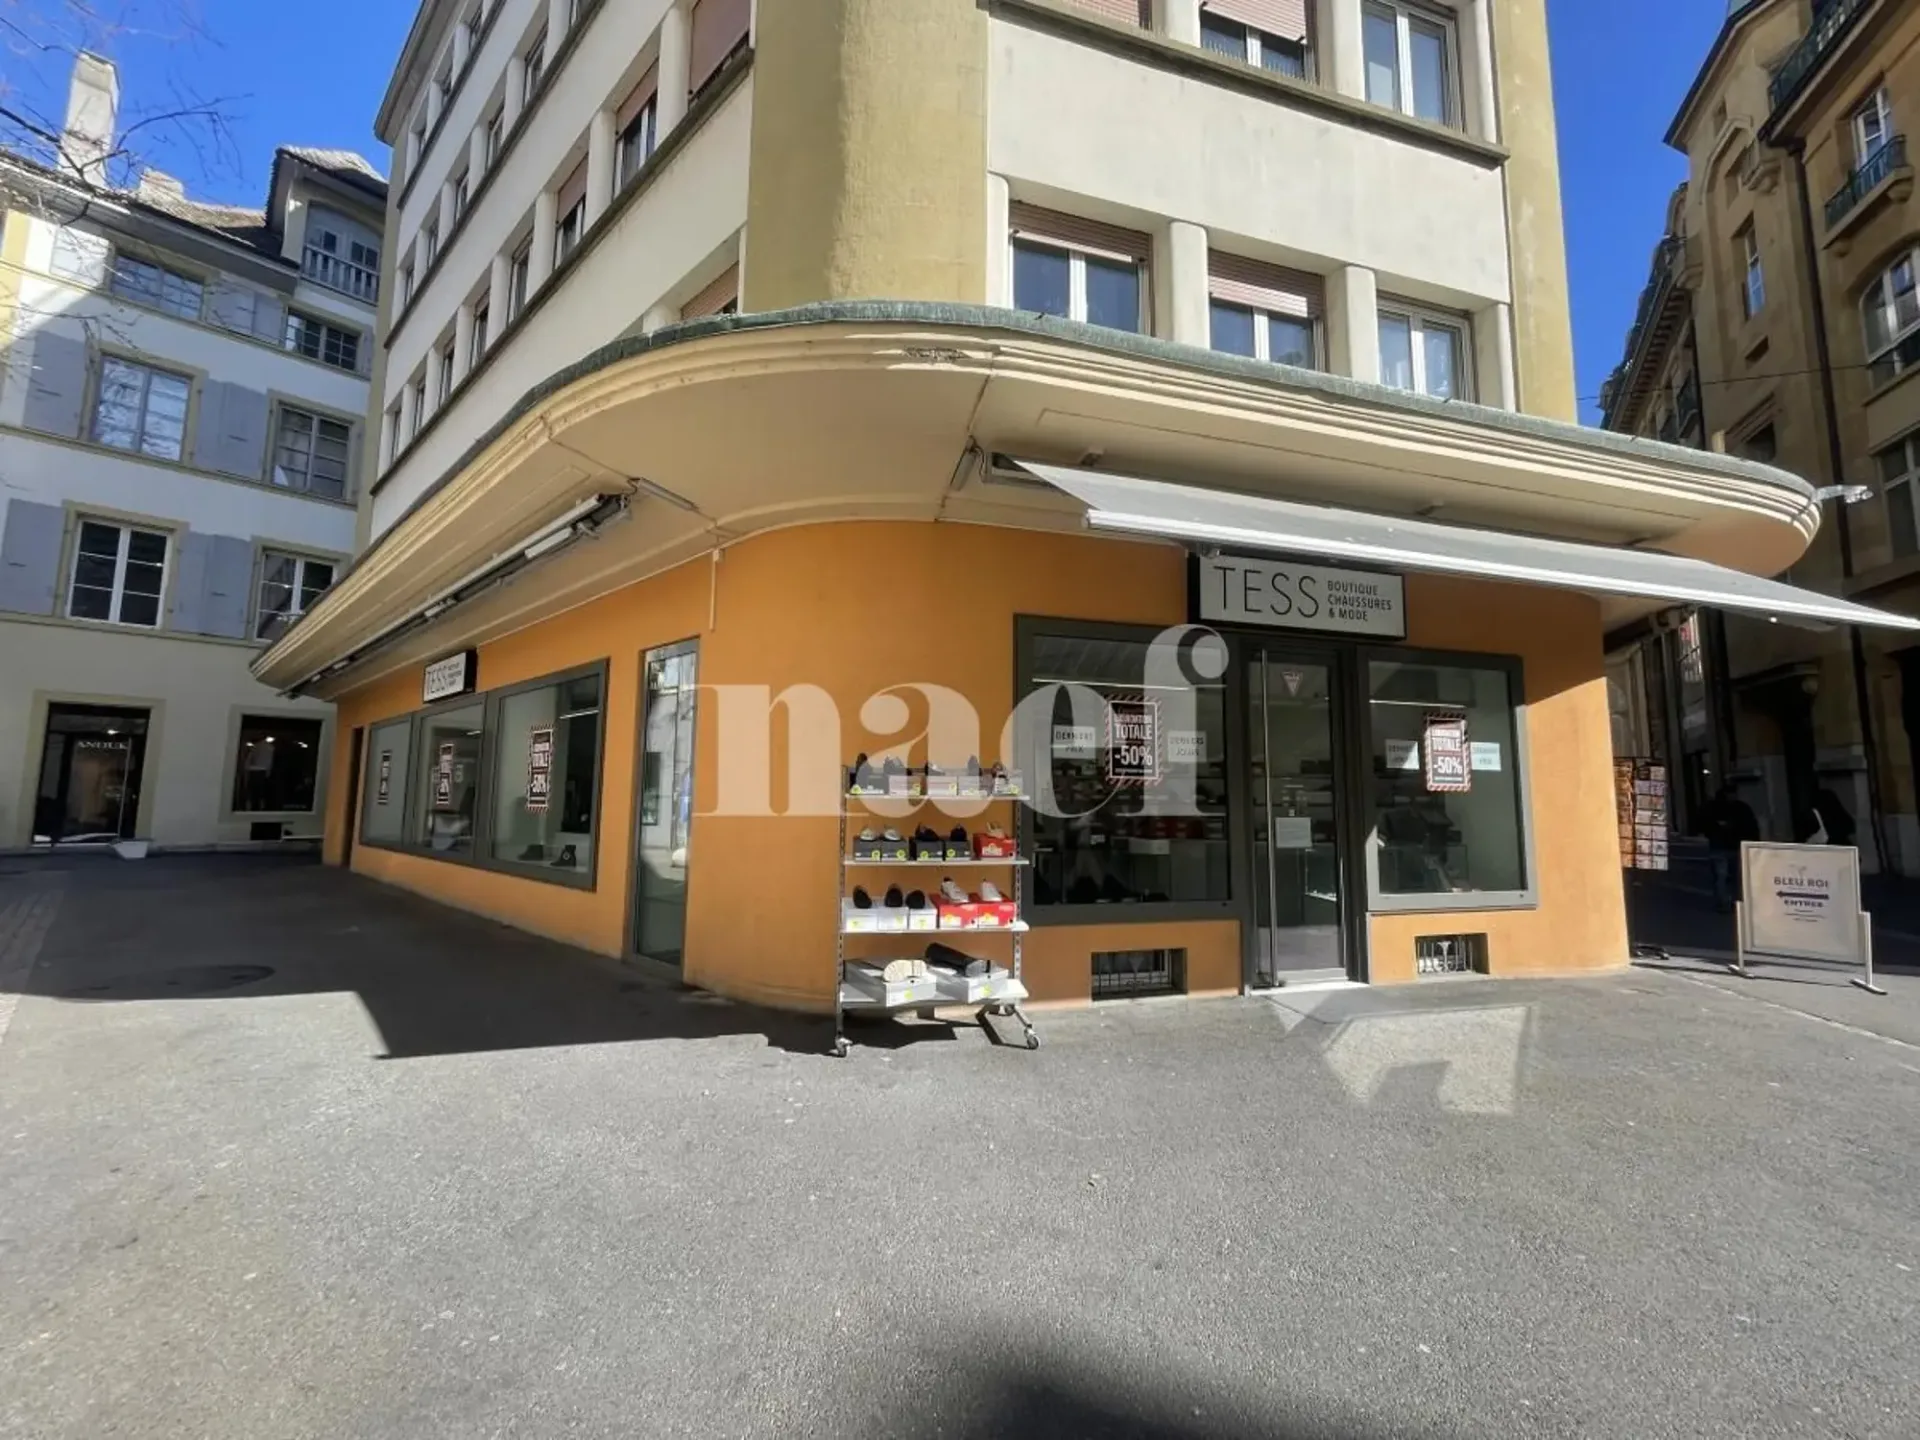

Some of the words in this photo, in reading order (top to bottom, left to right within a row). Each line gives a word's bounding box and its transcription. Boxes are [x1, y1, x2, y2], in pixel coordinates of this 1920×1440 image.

[1213, 565, 1320, 619] TESS
[1327, 579, 1379, 596] BOUTIQUE
[1327, 595, 1393, 612] CHAUSSURES
[1328, 607, 1336, 618] &
[1338, 606, 1368, 622] MODE
[1114, 724, 1153, 740] TOTALE
[1114, 745, 1153, 766] -50%
[1433, 756, 1463, 774] -50%
[1773, 876, 1804, 887] BLEU
